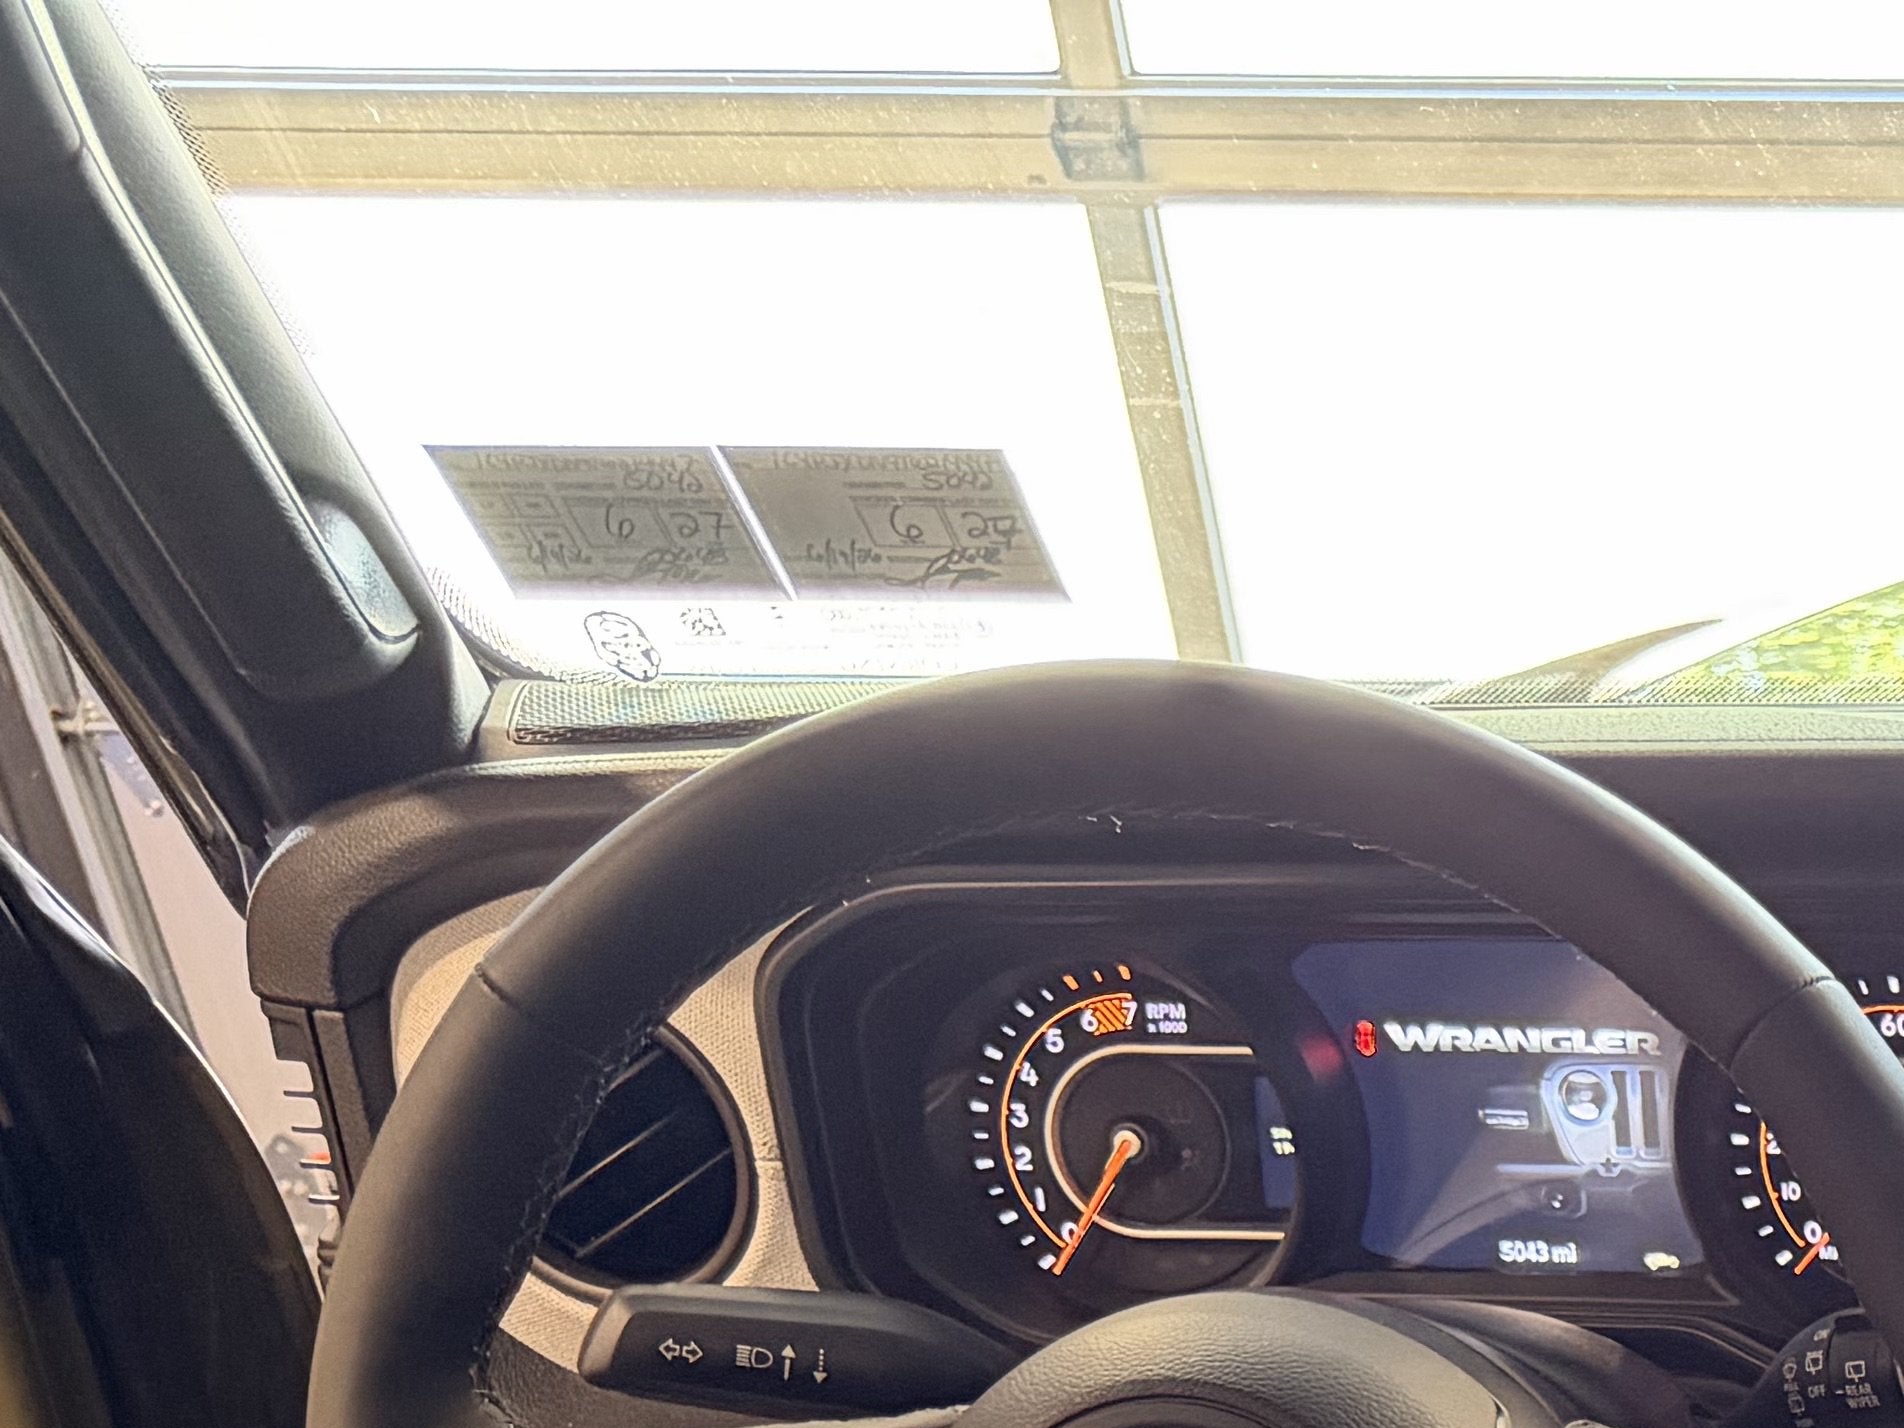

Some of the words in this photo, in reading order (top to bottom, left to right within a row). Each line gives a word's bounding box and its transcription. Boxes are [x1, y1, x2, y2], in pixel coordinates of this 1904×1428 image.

[1079, 1008, 1099, 1033] 6
[1120, 1001, 1138, 1025] 7
[1146, 1002, 1187, 1021] RPM
[1045, 1030, 1065, 1054] 5
[1383, 1021, 1662, 1056] WRANGLER
[1018, 1061, 1039, 1087] 4
[1008, 1103, 1030, 1129] 3
[1013, 1147, 1034, 1171] 2
[1781, 1180, 1802, 1201] 10
[1551, 1239, 1578, 1264] mi
